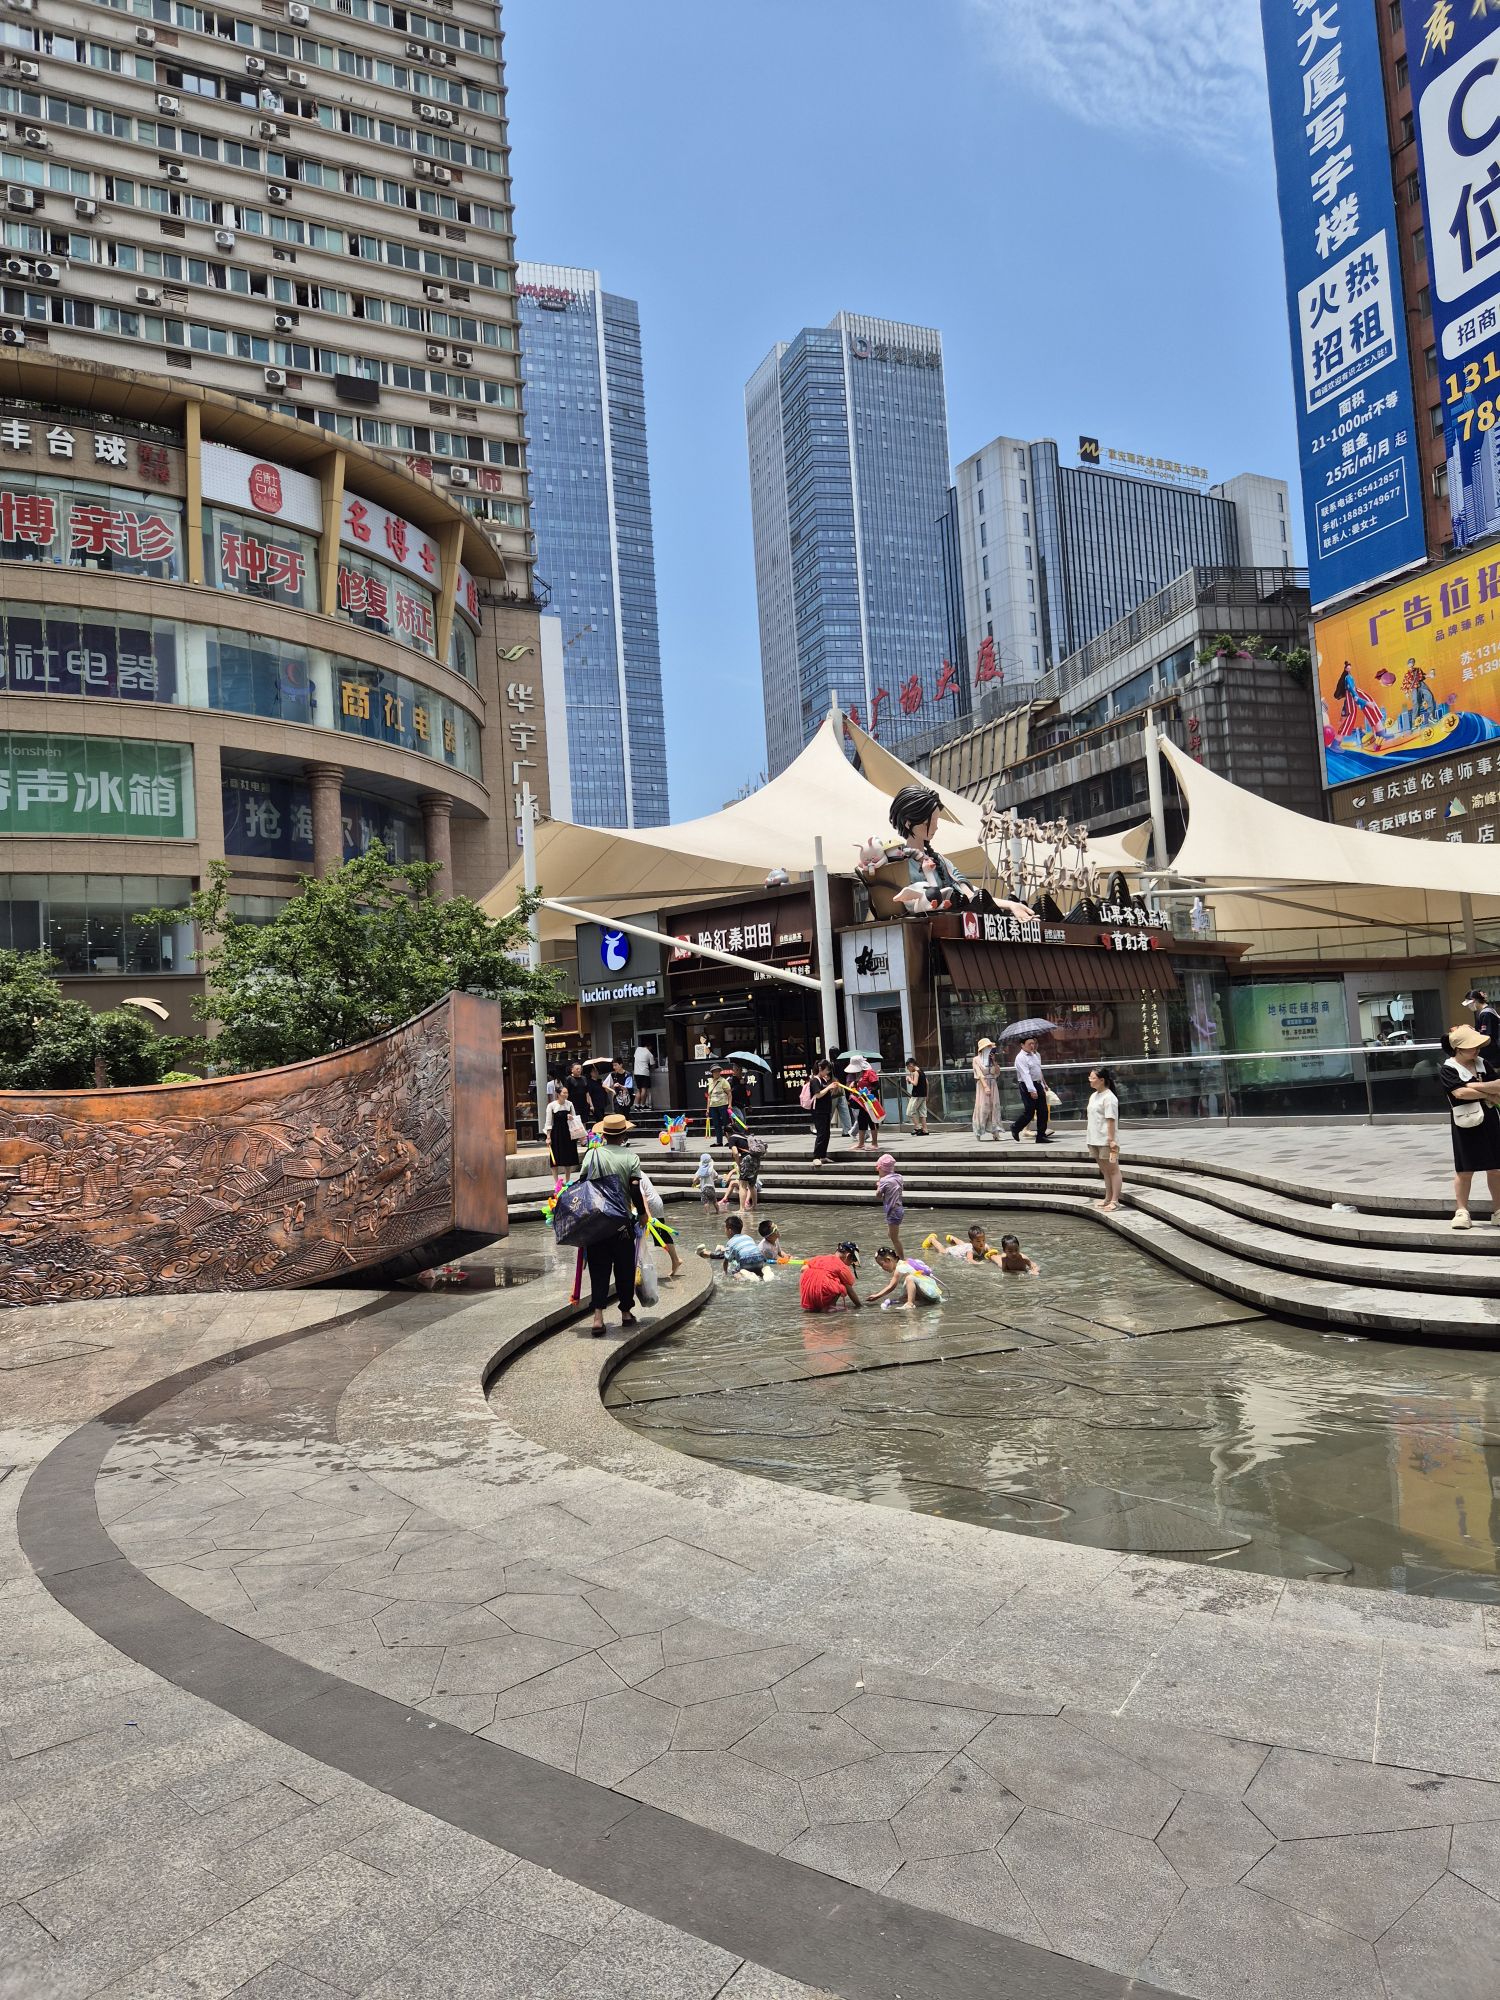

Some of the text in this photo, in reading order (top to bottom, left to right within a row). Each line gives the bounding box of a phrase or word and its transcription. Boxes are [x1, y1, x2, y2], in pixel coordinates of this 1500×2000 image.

[1290, 0, 1361, 260] 大厦写字楼
[1311, 302, 1385, 381] 招租
[1338, 389, 1366, 418] 面积
[1457, 393, 1500, 442] 78
[1341, 432, 1369, 459] 租金
[1394, 430, 1408, 448] 起
[344, 500, 436, 574] 名博士
[221, 532, 307, 594] 种牙
[0, 643, 160, 692] 社电器
[1462, 659, 1500, 683] 吴:139
[1424, 807, 1438, 820] 8F
[582, 986, 611, 1003] luckin
[612, 983, 645, 999] coffee
